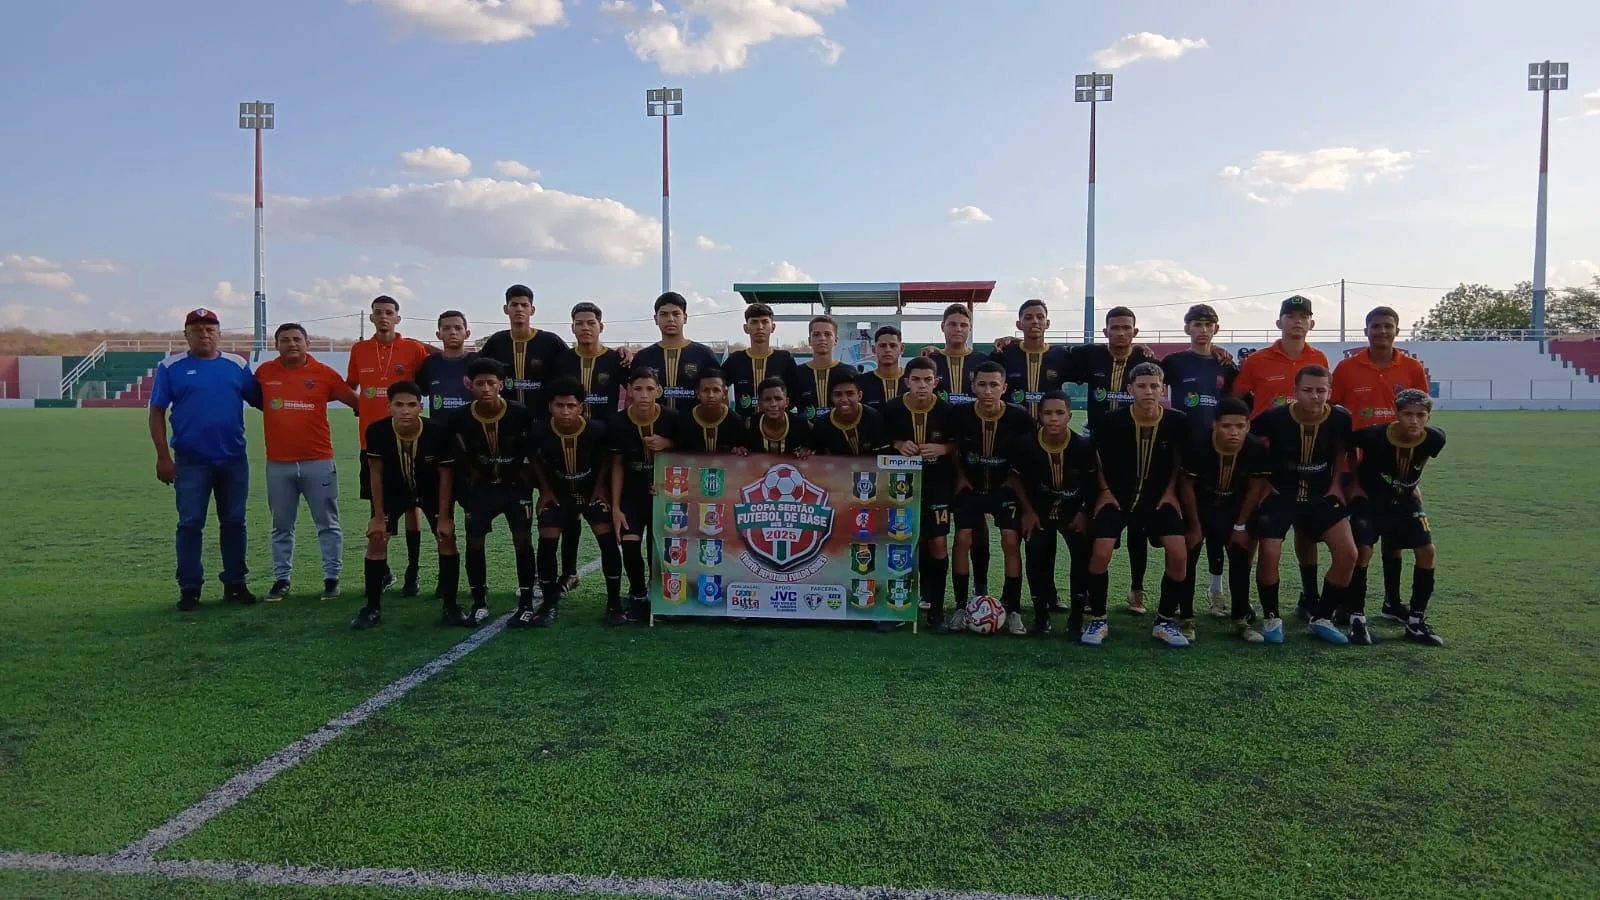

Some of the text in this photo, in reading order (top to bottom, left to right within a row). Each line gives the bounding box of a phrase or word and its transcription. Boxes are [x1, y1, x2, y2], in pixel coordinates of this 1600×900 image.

[750, 503, 815, 514] COPA SERTÃO
[737, 511, 827, 527] FUTEBOL DE BASE
[935, 509, 949, 525] 14
[766, 530, 797, 540] 2025
[770, 591, 797, 602] JVC
